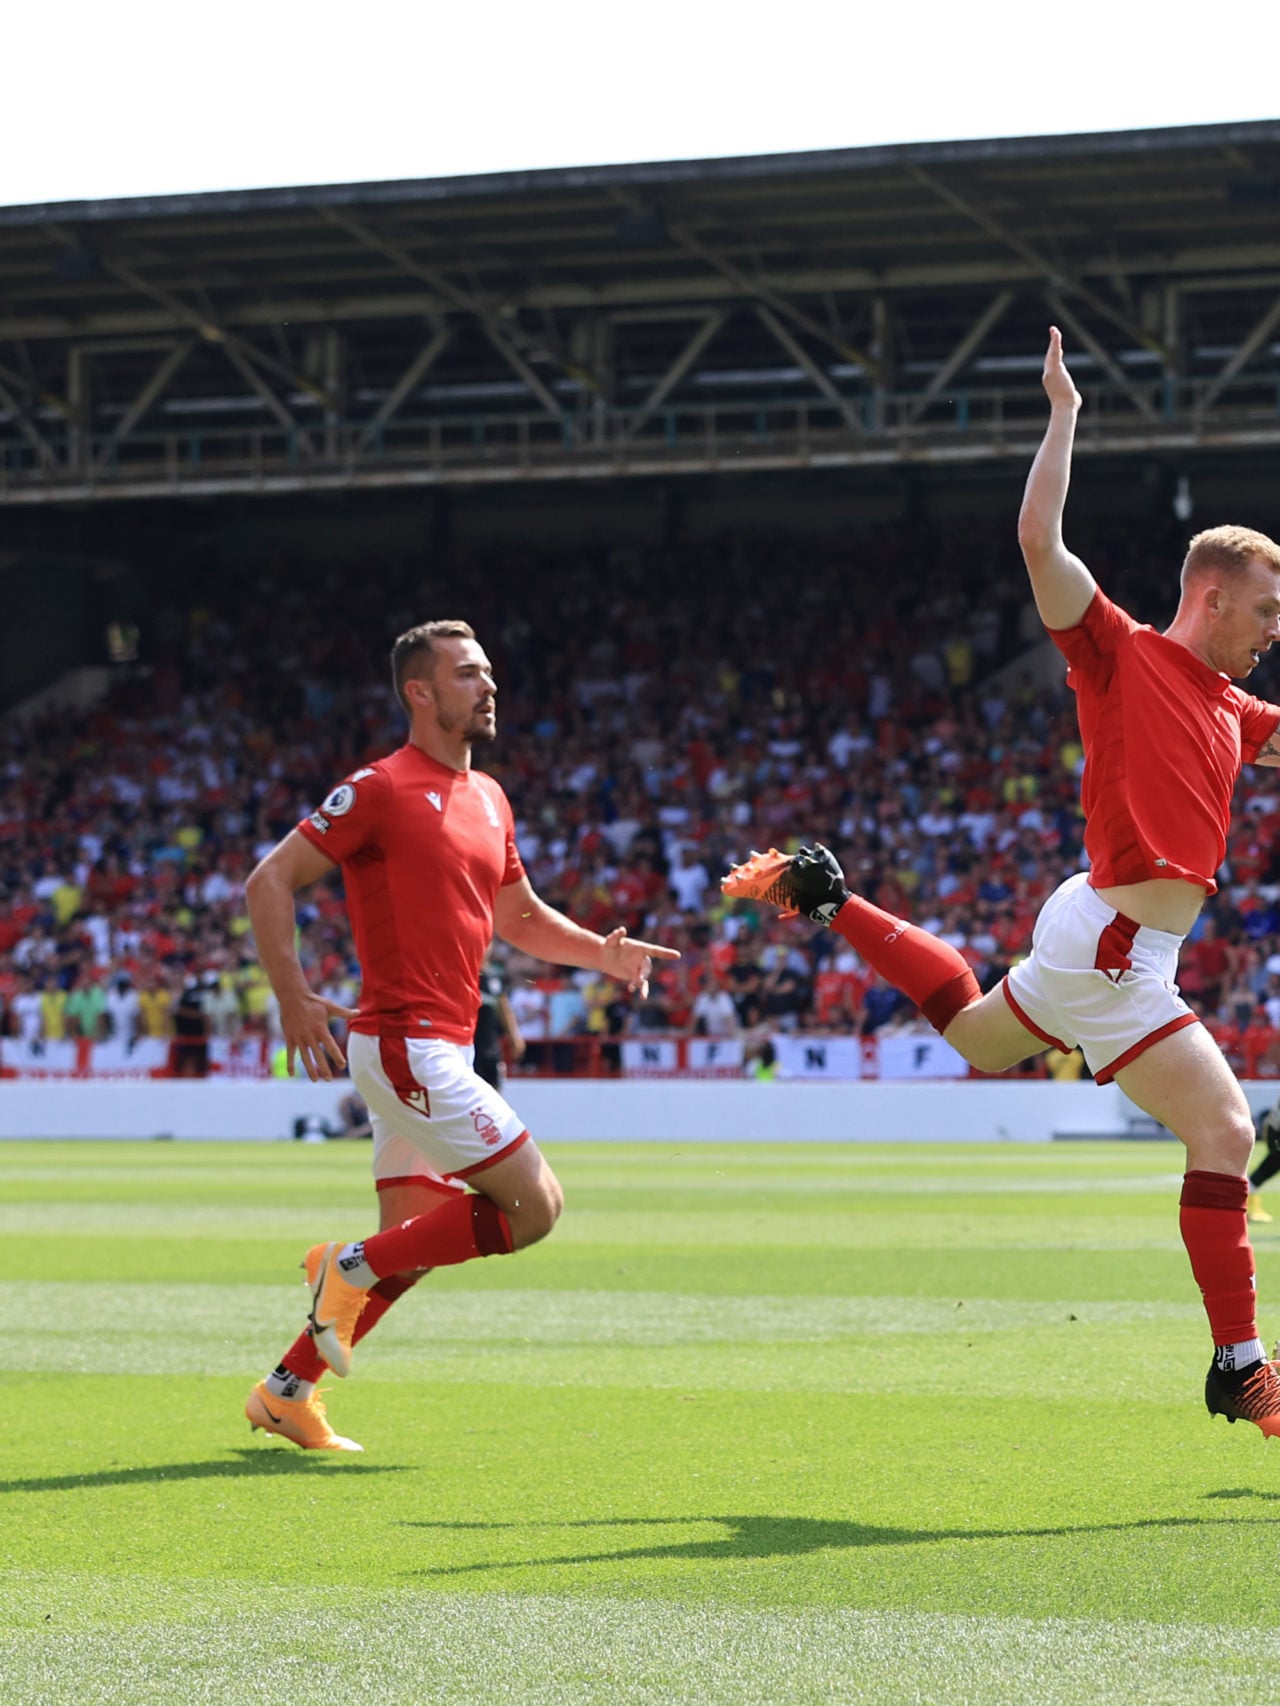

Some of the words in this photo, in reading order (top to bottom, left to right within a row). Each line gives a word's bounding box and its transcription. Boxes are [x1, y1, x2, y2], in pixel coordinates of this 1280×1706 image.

[641, 1046, 660, 1063] N
[804, 1046, 827, 1071] N
[912, 1045, 931, 1070] F
